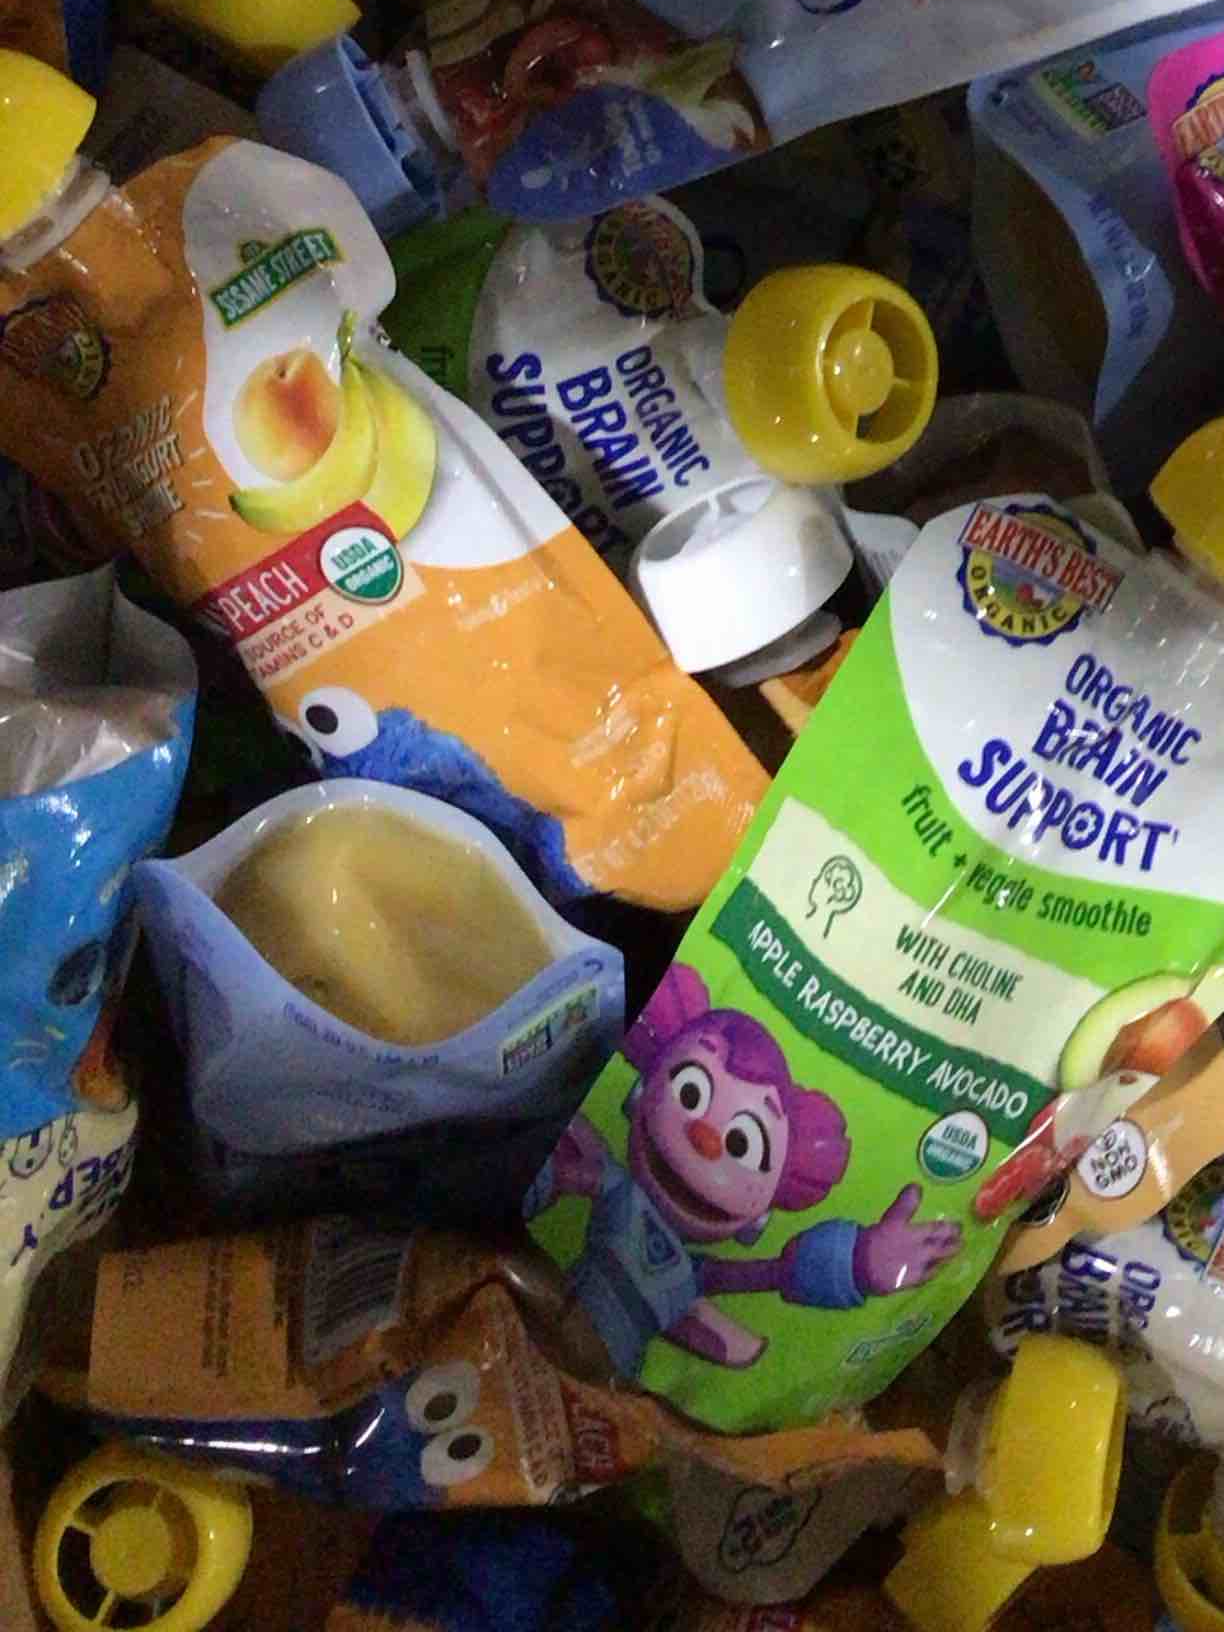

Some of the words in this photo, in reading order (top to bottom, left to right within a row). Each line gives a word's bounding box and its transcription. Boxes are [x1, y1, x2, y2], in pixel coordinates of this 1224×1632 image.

[217, 270, 275, 322] SESAME
[277, 230, 333, 281] STREET
[556, 364, 665, 511] BRAIN
[616, 347, 710, 489] ORGANIC
[224, 563, 307, 627] PEACH
[331, 540, 378, 573] USDA
[345, 557, 397, 592] ORGANIC
[965, 505, 1069, 580] EARTH'S
[1055, 550, 1121, 608] BEST
[967, 563, 1071, 632] ORGANIC
[302, 604, 329, 628] OF
[1030, 696, 1168, 808] BRAIN
[1064, 652, 1203, 768] ORGANIC
[958, 738, 1178, 873] SUPPORT
[899, 782, 949, 857] fruit
[966, 856, 1036, 917] veggie
[1042, 891, 1150, 936] smoothie
[895, 928, 947, 976] WITH
[949, 954, 1024, 1002] CHOLINE
[900, 972, 947, 1011] AND
[946, 989, 982, 1025] DHA
[748, 921, 802, 990] APPLE
[797, 963, 924, 1097] RASPBERRY
[928, 1060, 1029, 1119] AVOCADO
[940, 1121, 980, 1153] USDA
